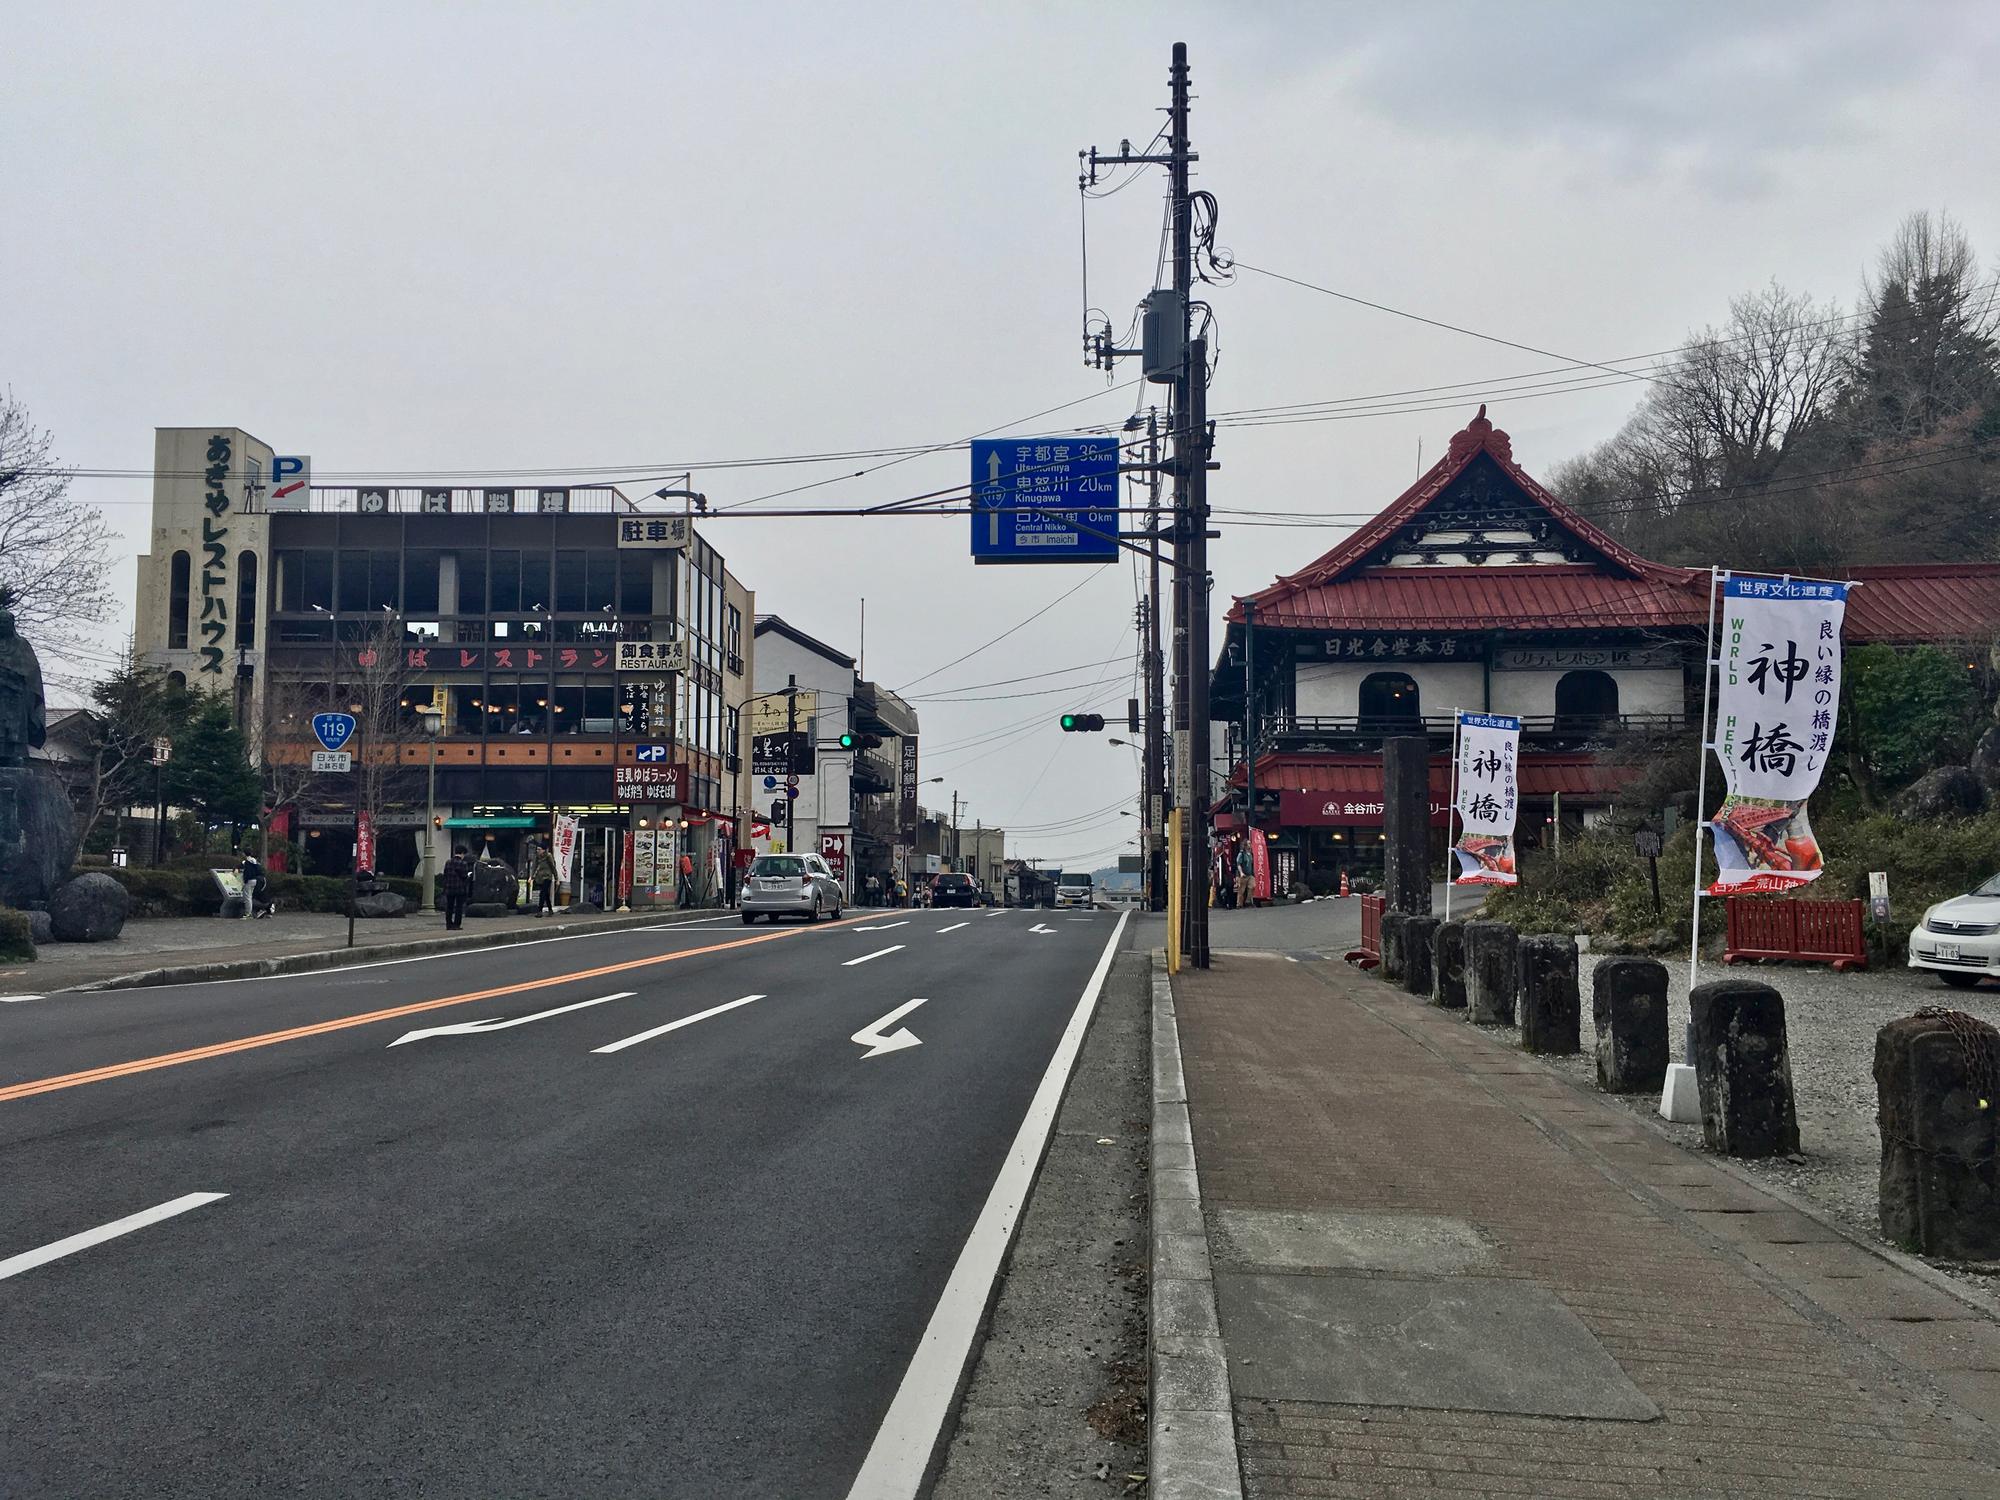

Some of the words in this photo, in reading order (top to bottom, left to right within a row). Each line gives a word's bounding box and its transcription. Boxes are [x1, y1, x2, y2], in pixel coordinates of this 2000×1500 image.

[1016, 445, 1070, 462] 宇都宮
[1079, 444, 1112, 462] 36km
[272, 457, 303, 483] P
[1016, 476, 1069, 493] 鬼怒川
[1078, 475, 1112, 492] 20km
[1015, 493, 1061, 504] Kinugawa
[622, 519, 685, 542] 駐車場
[1015, 523, 1043, 531] Central
[1044, 523, 1067, 531] Nikko
[1020, 535, 1040, 545] 今市
[1046, 535, 1075, 544] Imaichi
[200, 435, 231, 673] あさやレストハウス
[1739, 581, 1834, 598] 世界文化遺産
[621, 643, 683, 659] 御食事処
[1325, 637, 1456, 656] 日光食堂本店
[1729, 618, 1744, 685] WORLD
[620, 659, 683, 669] RESTAURANT
[1807, 620, 1834, 772] 良い縁の橋渡し
[1741, 640, 1810, 777] 神橋
[322, 722, 345, 737] 119
[1467, 716, 1513, 729] 世界文化遺産
[317, 753, 347, 762] 日光市
[651, 746, 666, 761] P
[1463, 736, 1471, 773] WORLD
[616, 767, 678, 783] 豆乳ゆばラーメン
[903, 745, 916, 799] 足利銀行
[1503, 741, 1515, 820] 良い縁の橋渡し
[1469, 749, 1502, 823] 神橋
[822, 837, 834, 853] P
